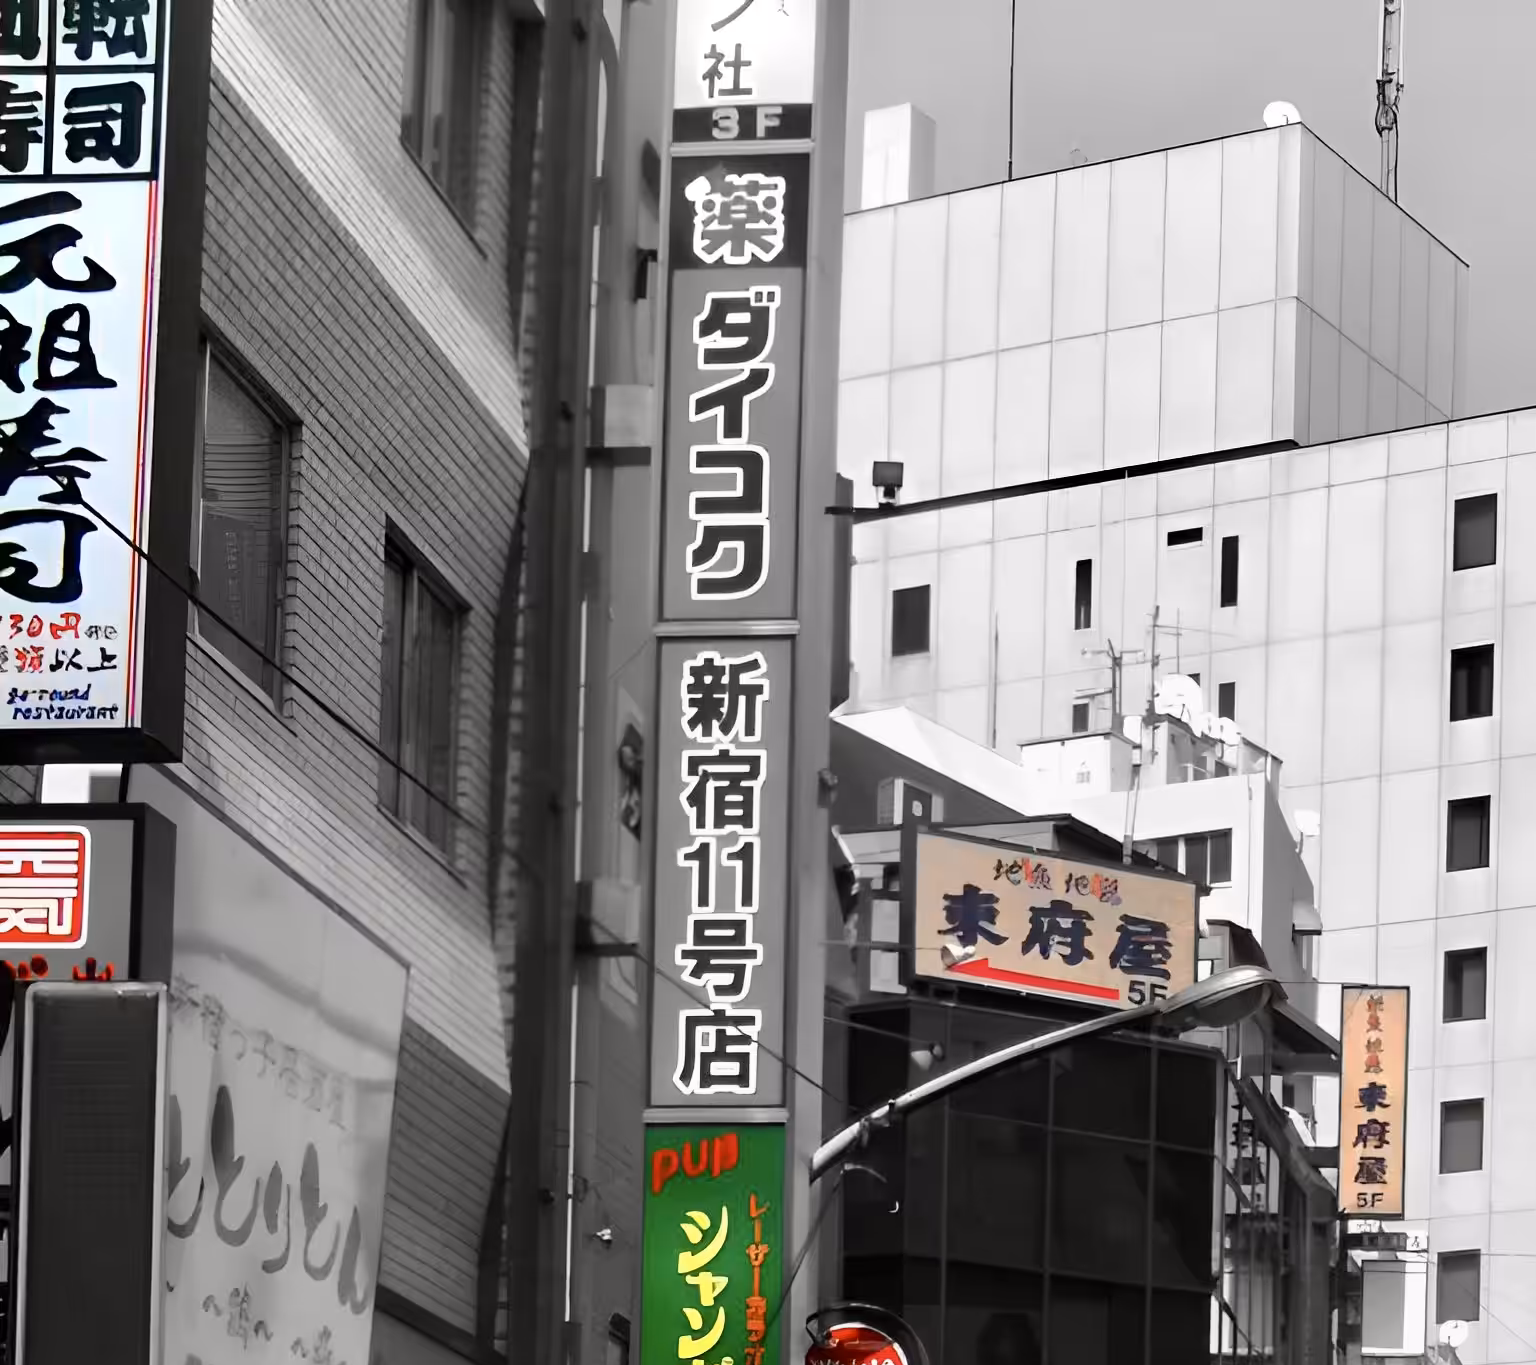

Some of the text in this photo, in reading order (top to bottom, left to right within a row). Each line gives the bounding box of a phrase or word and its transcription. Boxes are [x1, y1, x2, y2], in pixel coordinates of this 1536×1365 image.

[711, 106, 783, 140] 3F
[686, 285, 781, 600] ダイコク
[673, 651, 770, 1095] 新宿11号店
[1127, 980, 1168, 1005] 5F
[1356, 1192, 1384, 1208] 5F
